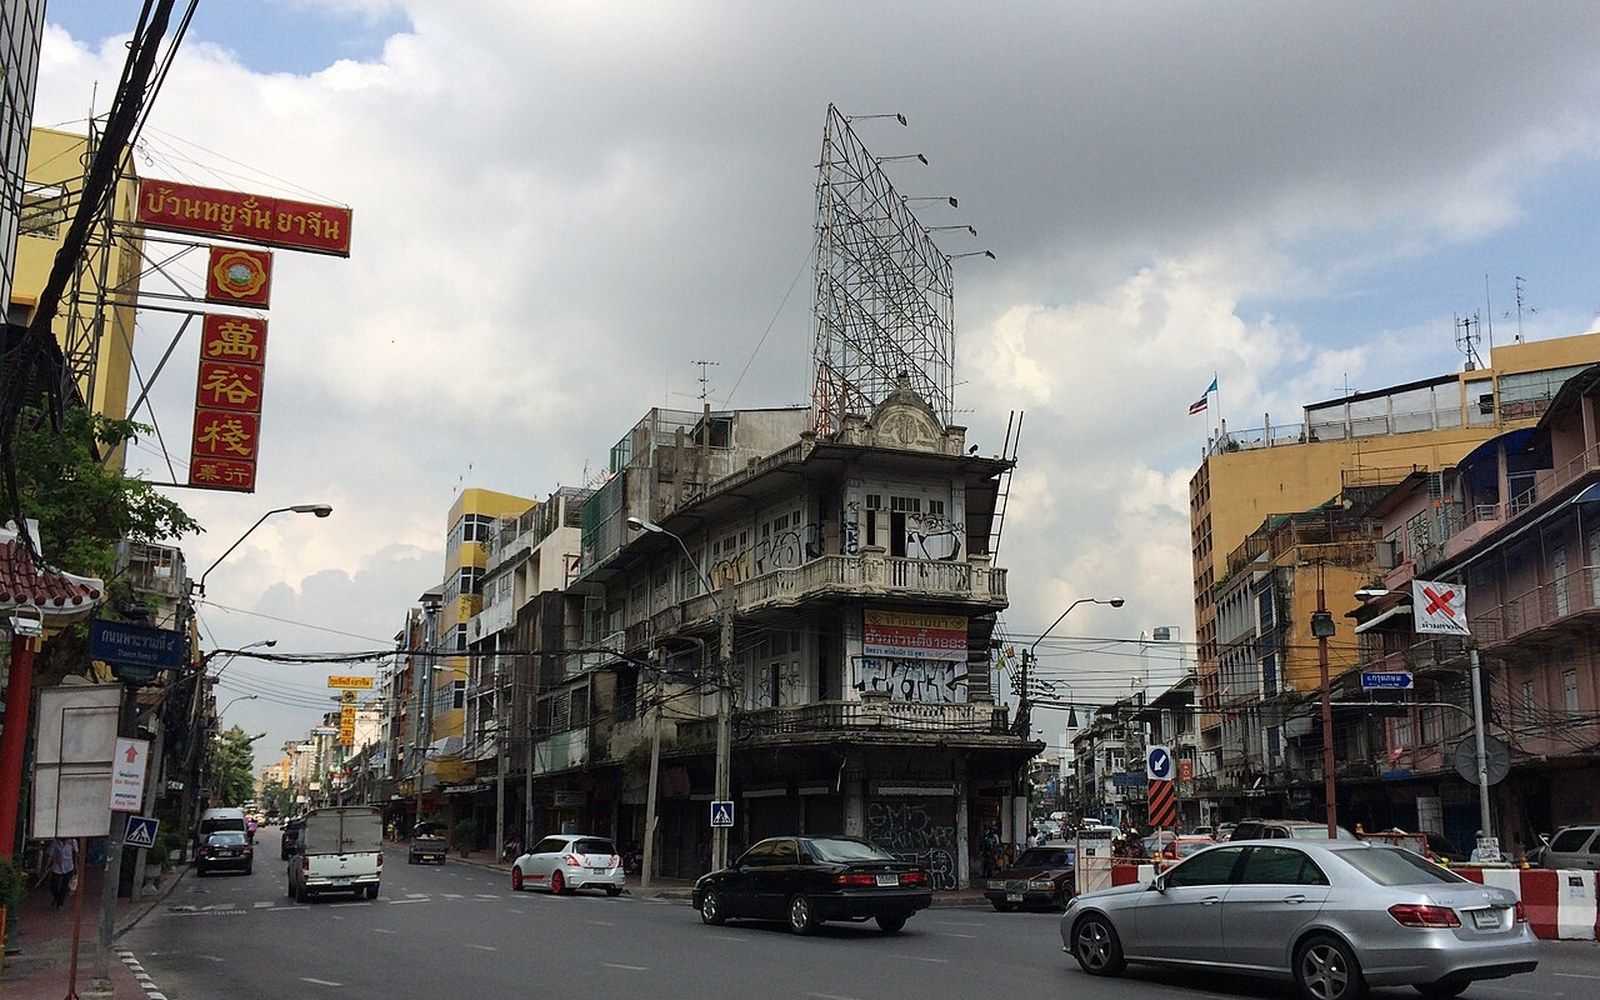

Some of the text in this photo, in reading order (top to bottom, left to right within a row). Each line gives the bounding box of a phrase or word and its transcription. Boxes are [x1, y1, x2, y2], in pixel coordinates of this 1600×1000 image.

[147, 187, 340, 240] บ้วนหยูจั่น ยาจีน
